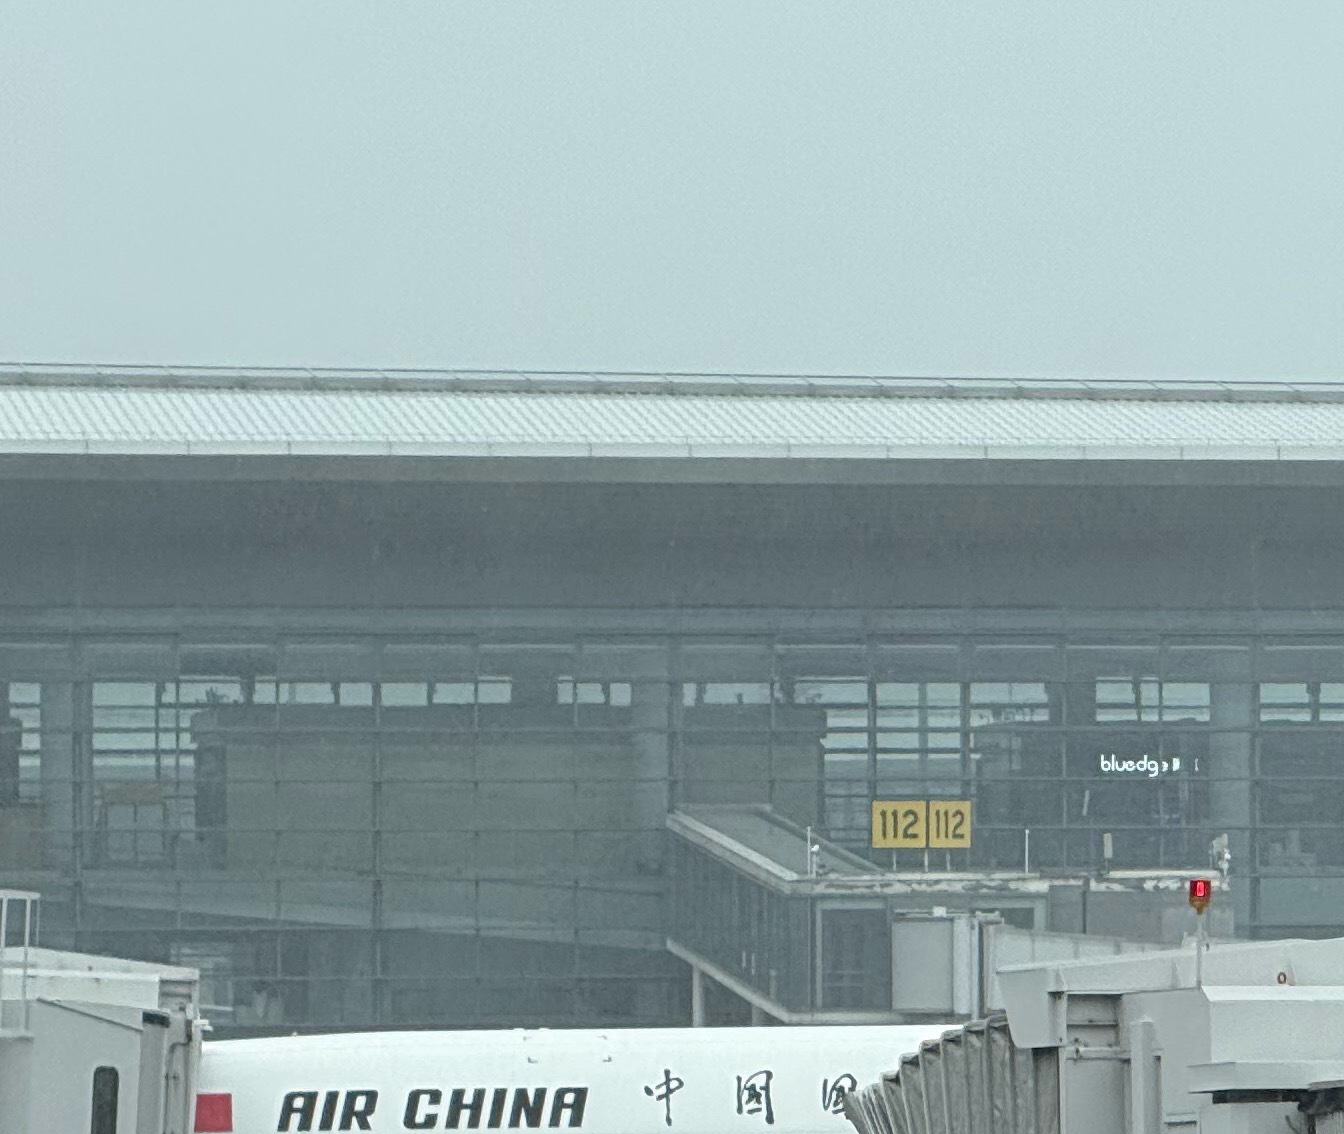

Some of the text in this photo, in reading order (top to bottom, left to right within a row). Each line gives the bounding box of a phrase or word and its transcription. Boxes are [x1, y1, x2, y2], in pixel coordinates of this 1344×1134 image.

[880, 809, 919, 839] 112
[935, 809, 965, 839] 112
[277, 1087, 588, 1132] AIR CHINA
